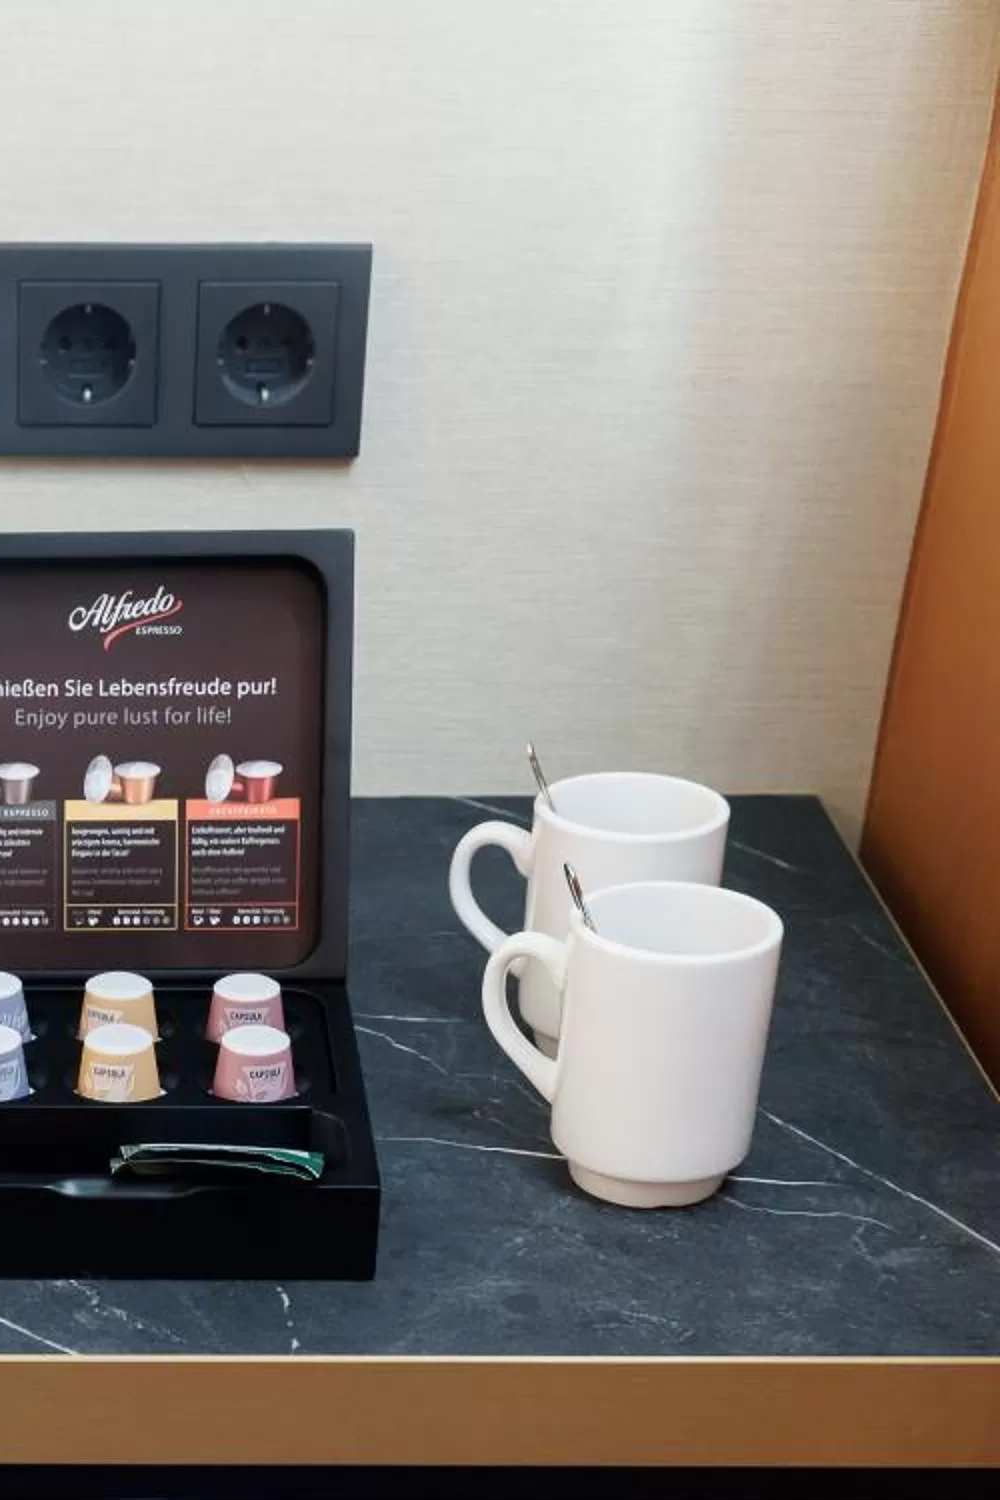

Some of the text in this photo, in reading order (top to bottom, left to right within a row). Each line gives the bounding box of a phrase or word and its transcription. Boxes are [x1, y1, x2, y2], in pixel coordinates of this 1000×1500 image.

[68, 585, 176, 633] Alfredo
[135, 624, 183, 635] ESPRESSO
[64, 679, 94, 697] Sie
[99, 678, 232, 697] Lebensfreude
[237, 678, 277, 700] pur!
[15, 706, 232, 731] Enjoy pure lust for life!
[3, 807, 49, 817] ESPRESSO
[229, 1011, 262, 1021] CAPSULA
[249, 1067, 282, 1078] CAPSULA
